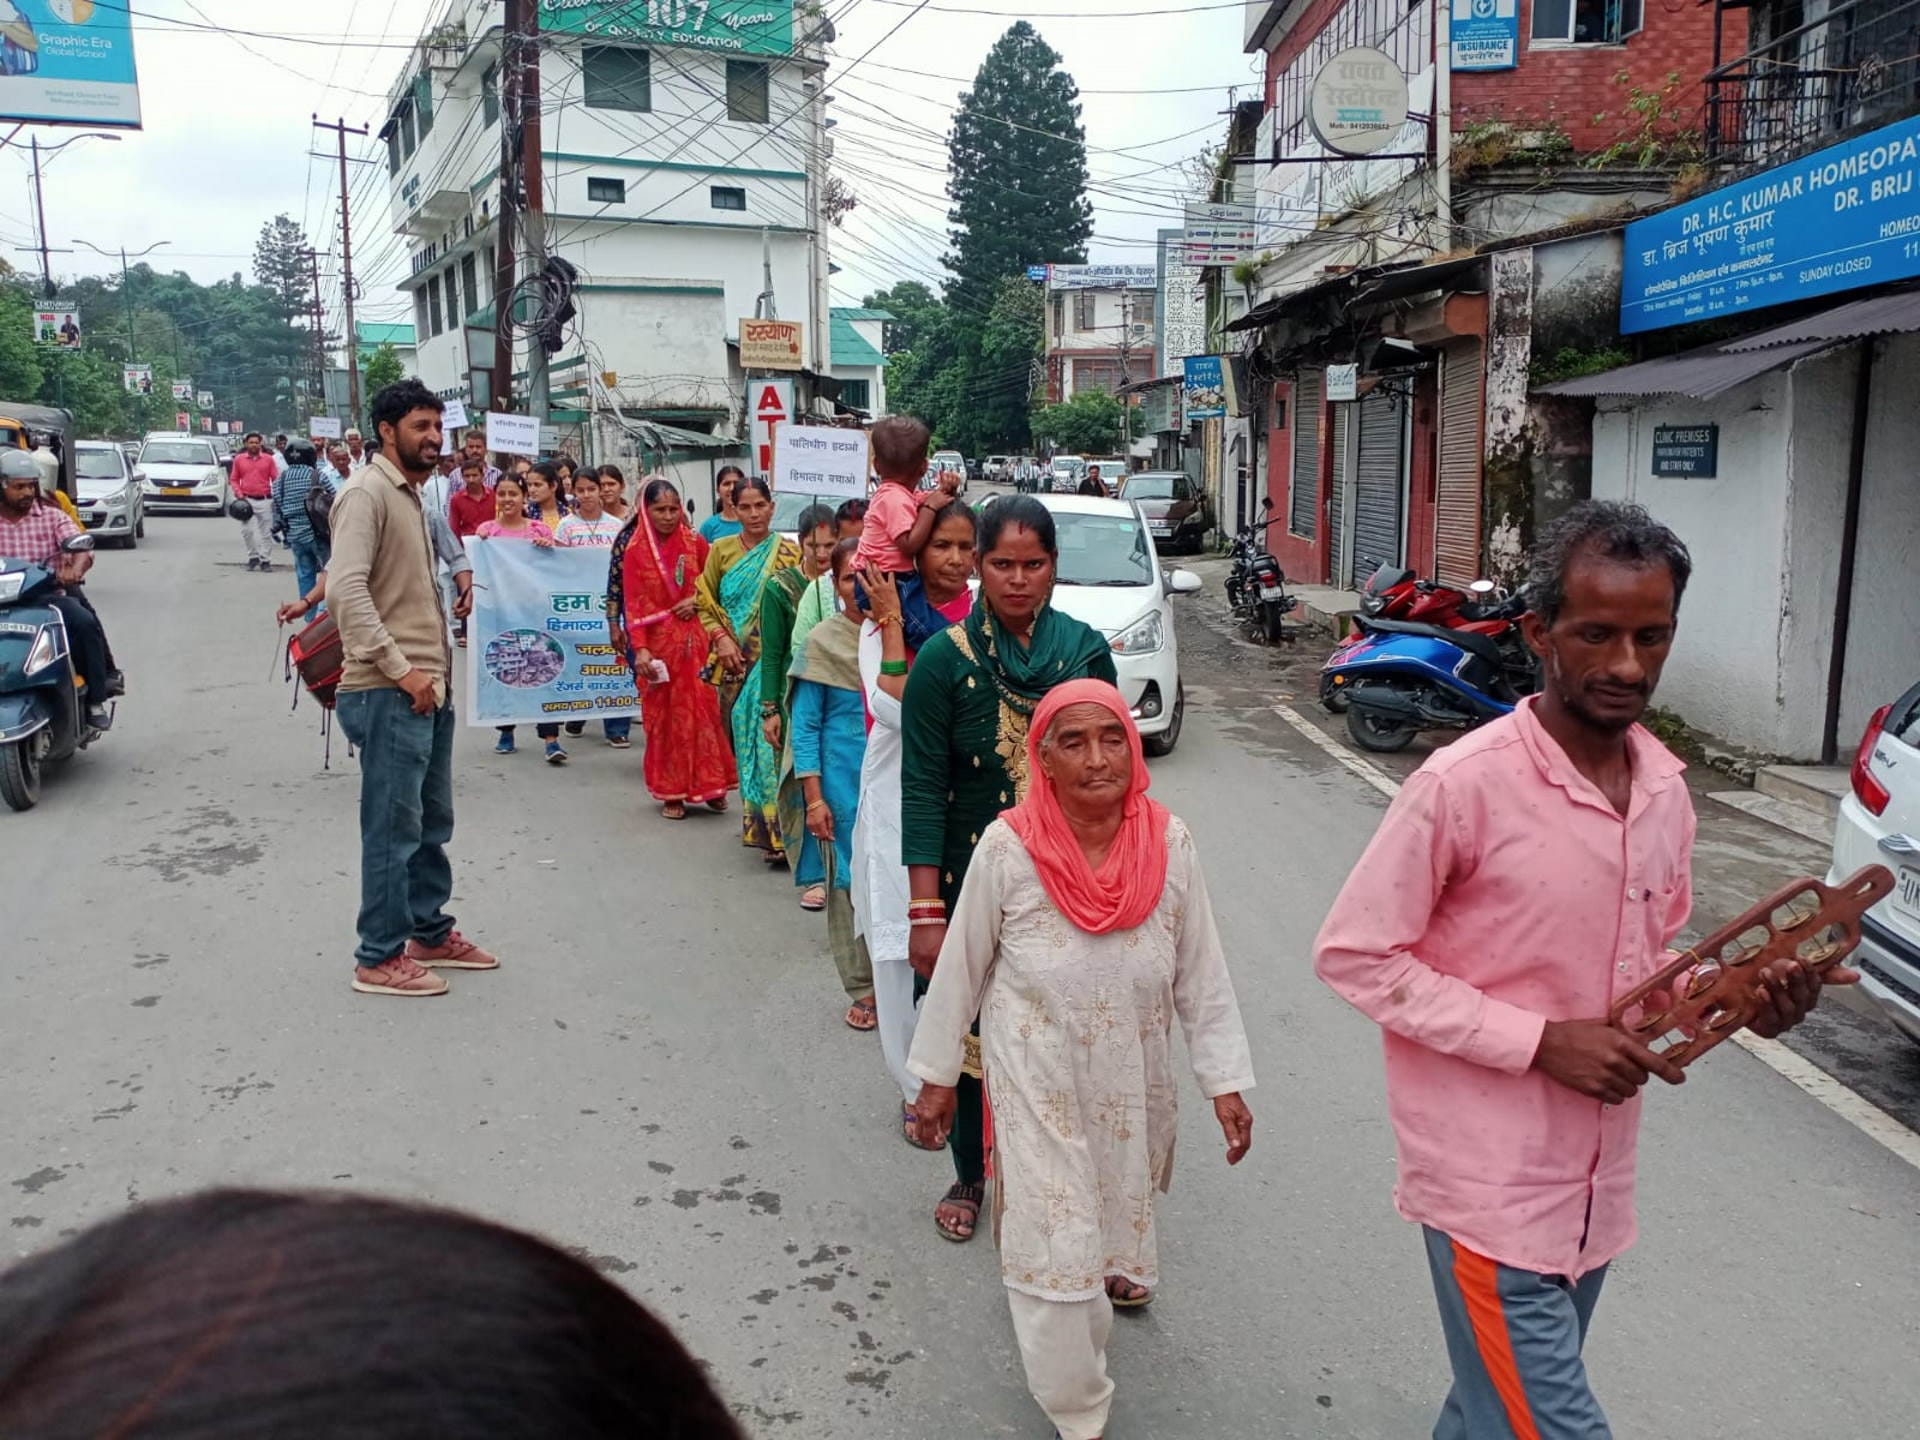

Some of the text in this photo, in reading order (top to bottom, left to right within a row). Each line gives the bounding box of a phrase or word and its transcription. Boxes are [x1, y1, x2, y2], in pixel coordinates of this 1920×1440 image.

[720, 12, 775, 30] Years
[40, 33, 113, 48] Graphic Era
[672, 31, 743, 49] EDUCATION
[1457, 40, 1509, 52] INSURANCE
[46, 46, 107, 58] Global School
[1834, 169, 1913, 212] DR. BRIJ
[1682, 213, 1704, 235] DR.
[1708, 201, 1736, 225] H.C.
[1741, 176, 1803, 215] KUMAR
[1642, 209, 1776, 266] डा. ब्रिज भूषण कुमार
[1799, 256, 1872, 283] SUNDAY CLOSED
[1655, 429, 1711, 444] CLINIC PREMISES
[790, 468, 824, 483] हिमालय
[576, 534, 613, 546] ZARA
[551, 594, 591, 613] हम
[546, 617, 603, 631] हिमालय
[581, 664, 627, 676] आपदा
[595, 695, 633, 708] 11:00
